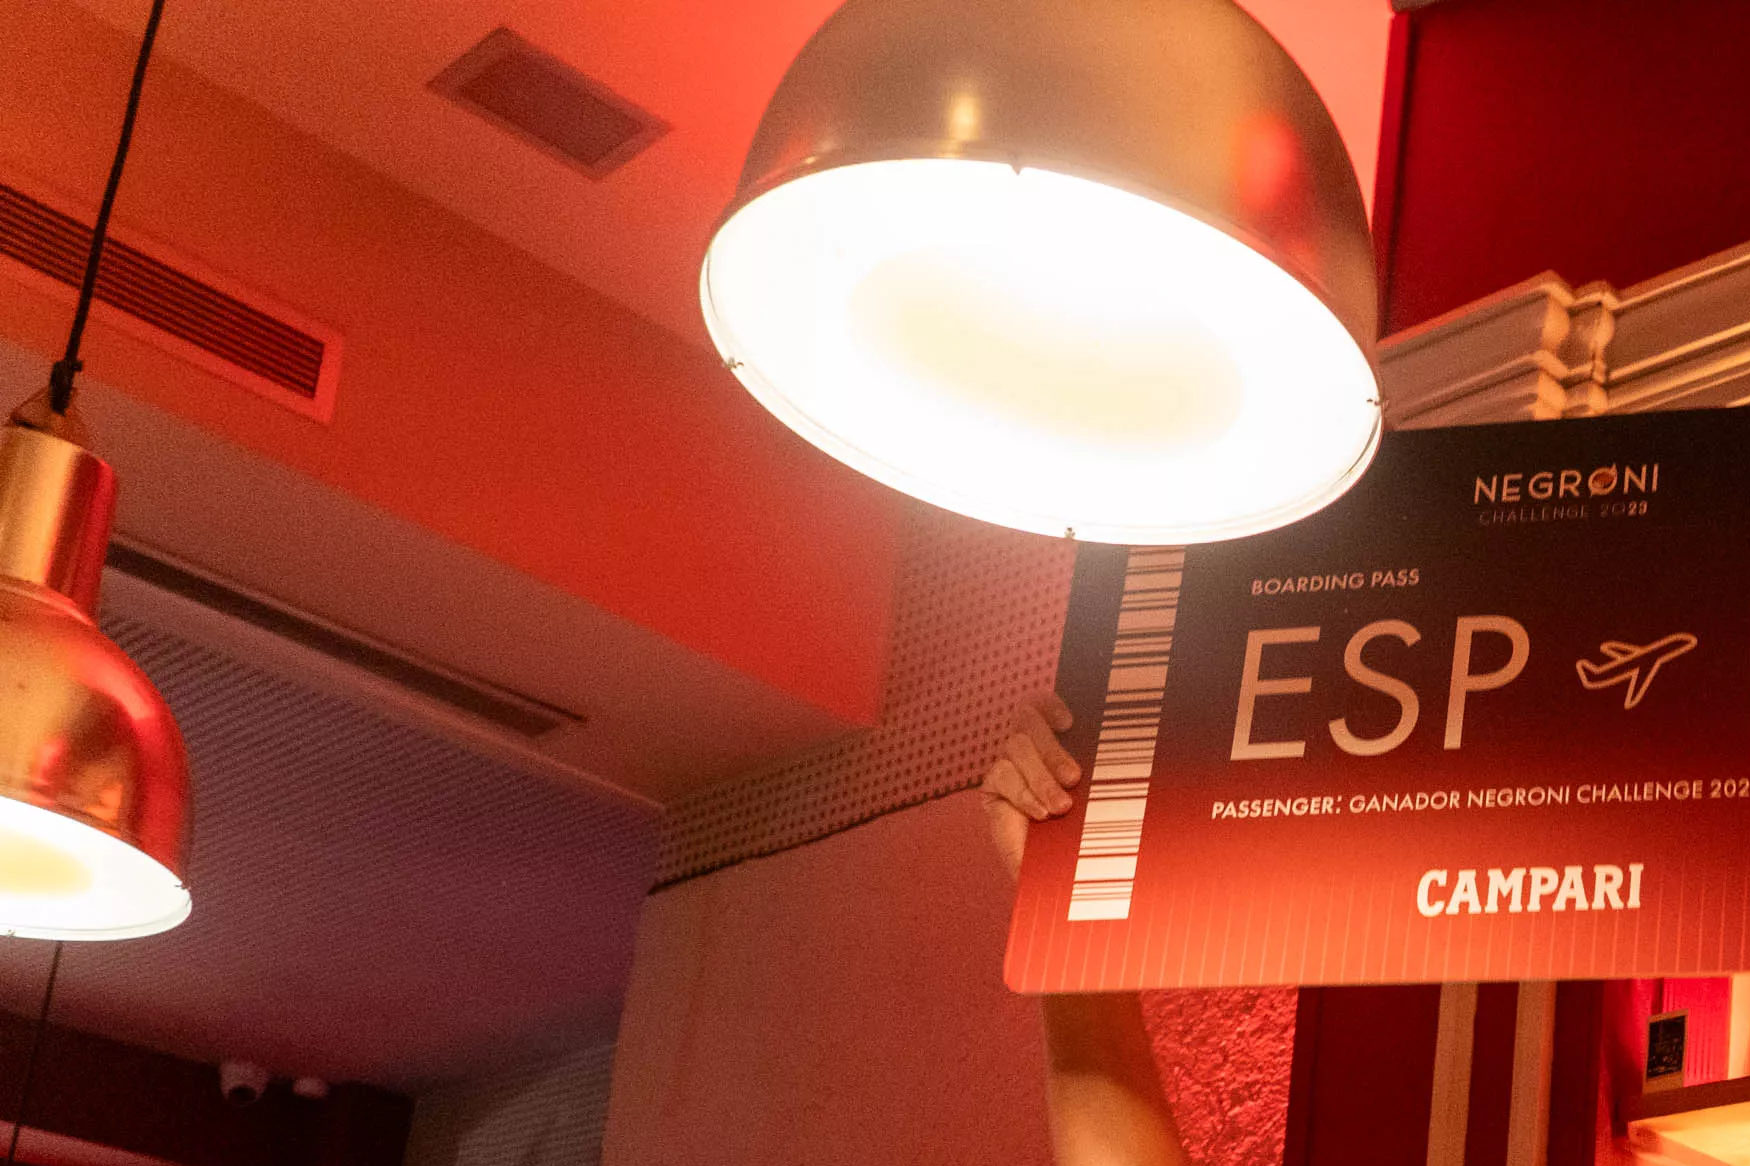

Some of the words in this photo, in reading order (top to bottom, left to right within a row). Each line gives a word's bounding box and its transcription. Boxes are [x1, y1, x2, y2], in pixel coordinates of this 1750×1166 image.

[1479, 505, 1593, 526] CHALLENGE
[1251, 571, 1365, 596] BOARDING
[1371, 568, 1421, 590] PASS
[1229, 614, 1531, 762] ESP
[1211, 793, 1342, 821] PASSENGER:
[1349, 789, 1461, 815] GANADOR
[1467, 785, 1571, 808] NEGRONI
[1577, 779, 1704, 804] CHALLENGE
[1416, 862, 1644, 917] CAMPARI
